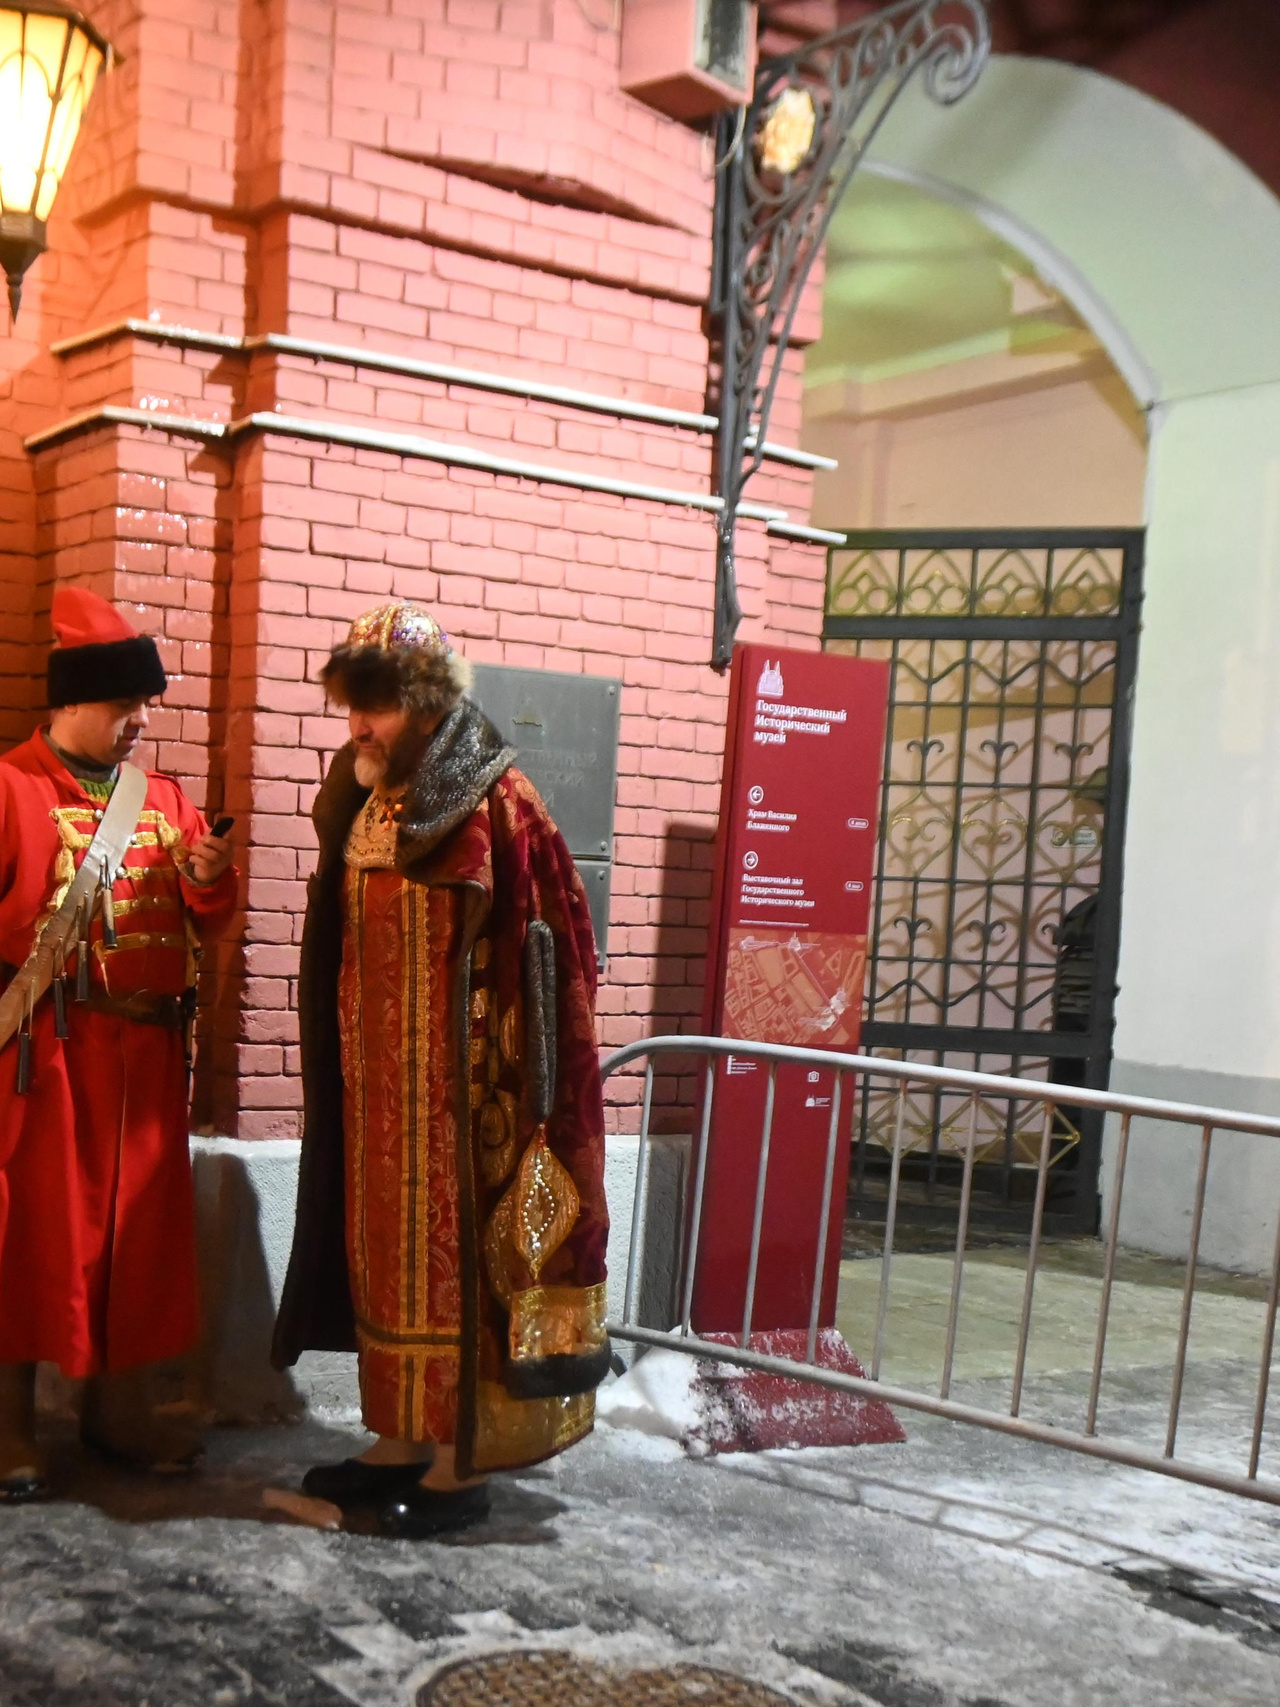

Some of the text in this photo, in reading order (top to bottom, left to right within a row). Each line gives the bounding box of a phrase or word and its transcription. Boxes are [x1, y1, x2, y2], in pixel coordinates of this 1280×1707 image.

[756, 699, 848, 723] Государственный
[754, 714, 831, 734] Исторический
[753, 731, 787, 746] музей
[747, 808, 797, 822] Храм Василия
[746, 821, 790, 832] Блаженного
[742, 874, 804, 885] Выставочный зал
[741, 884, 804, 896] Государственного
[740, 895, 815, 908] Исторического музея
